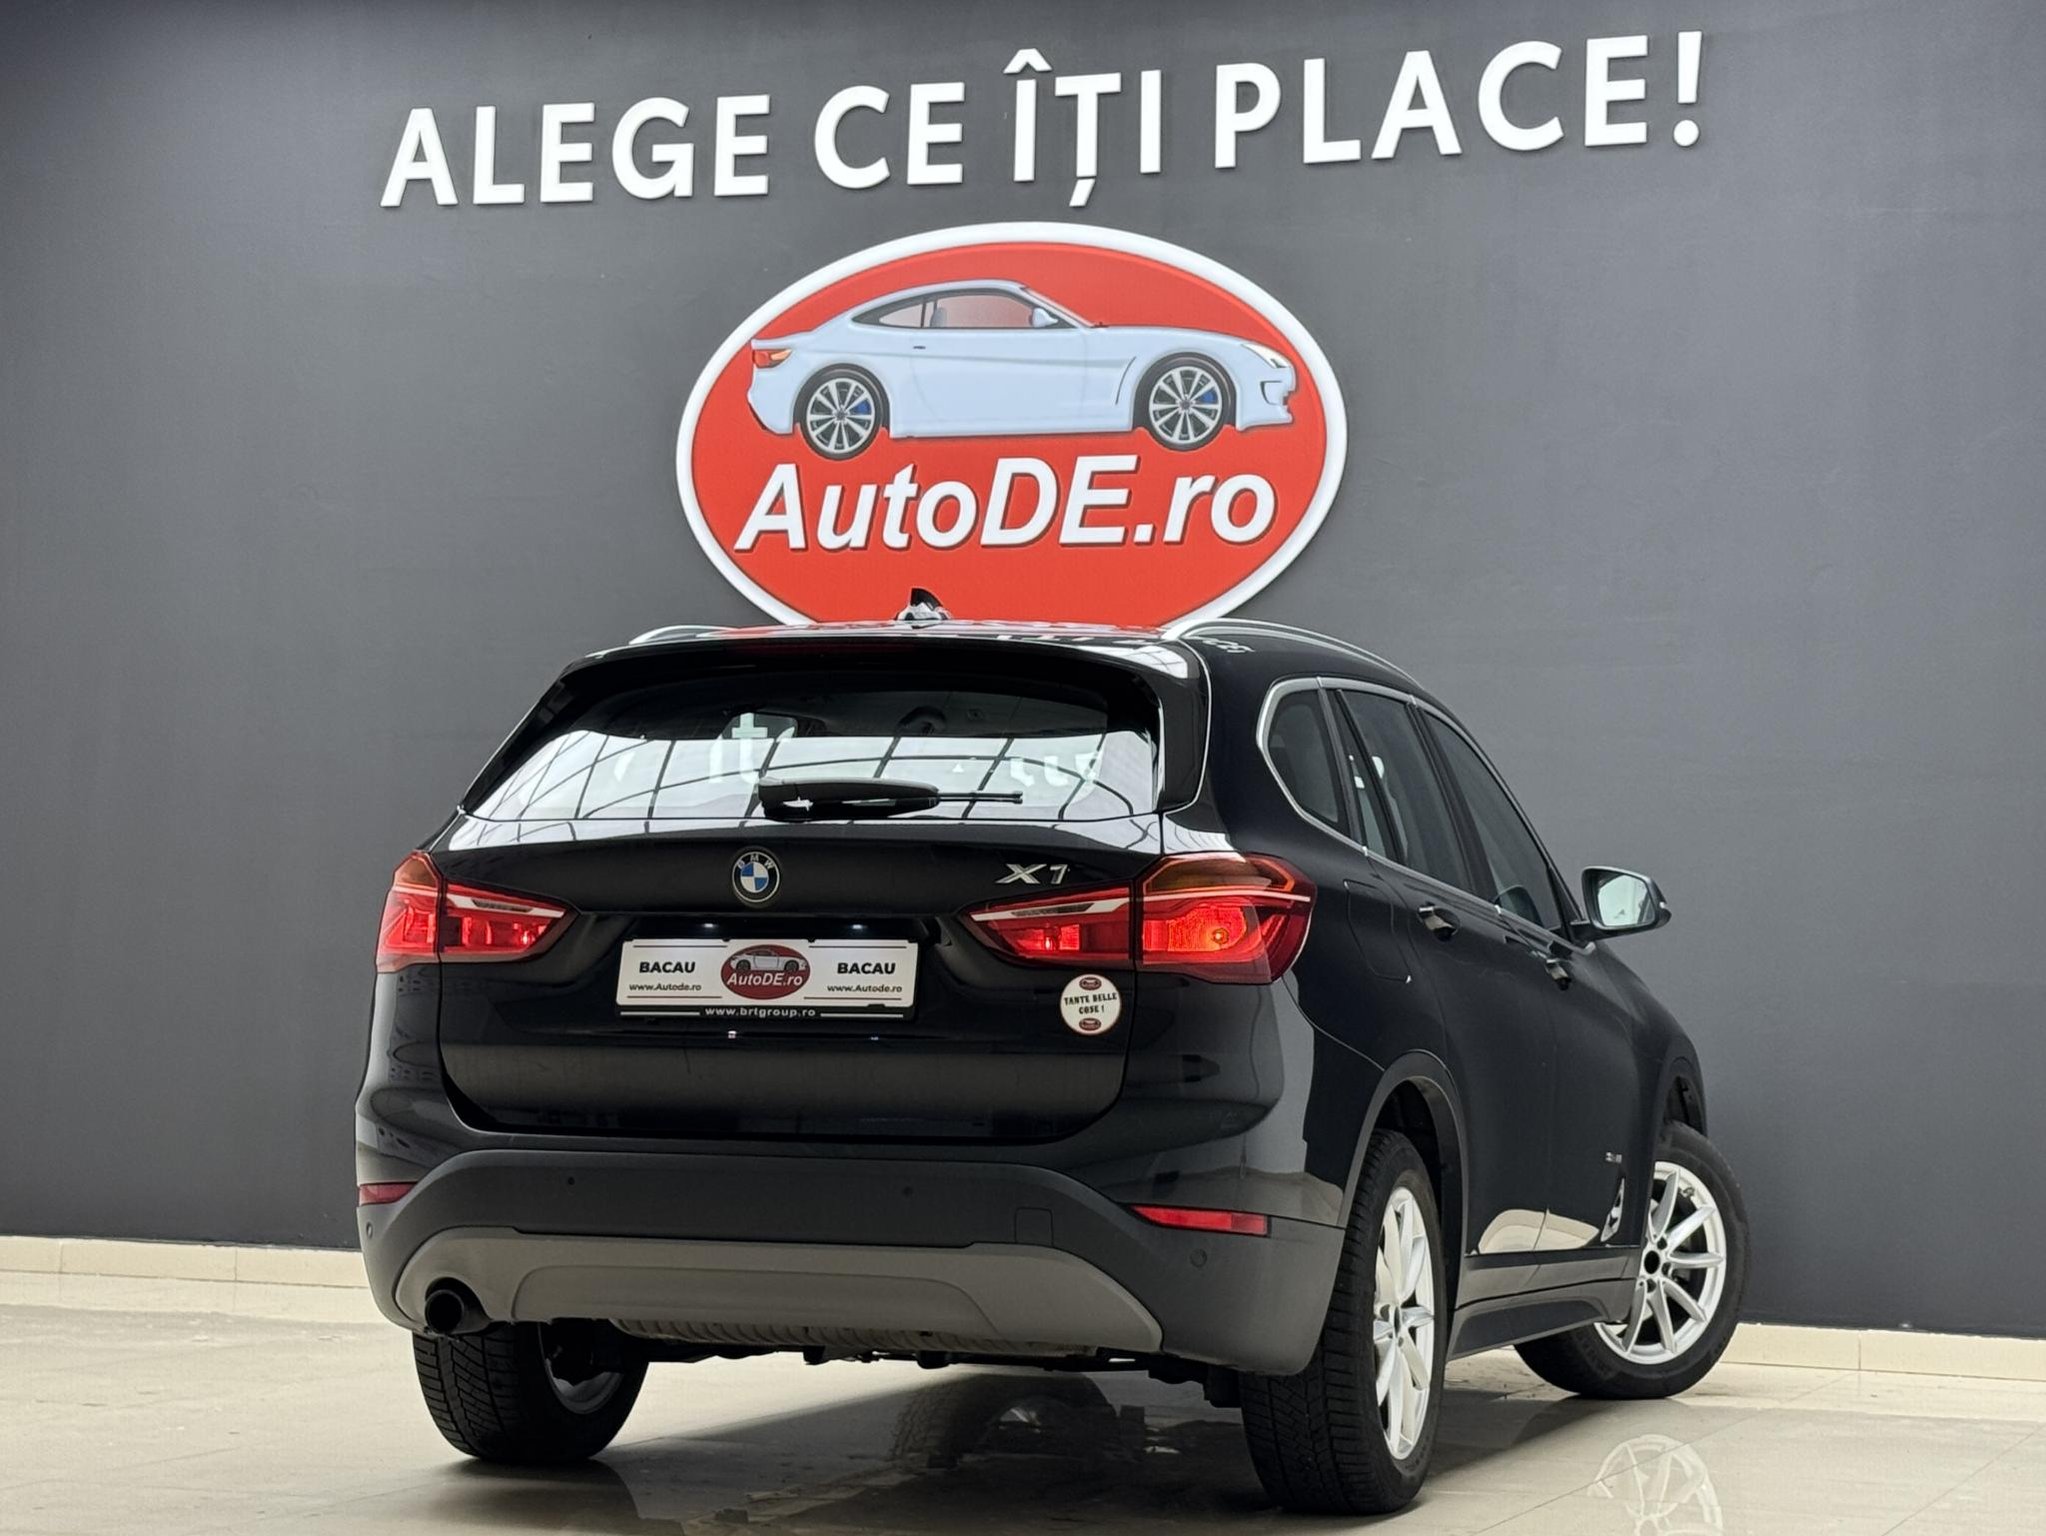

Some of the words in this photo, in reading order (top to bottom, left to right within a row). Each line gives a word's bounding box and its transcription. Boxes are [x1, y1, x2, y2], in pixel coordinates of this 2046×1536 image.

[380, 94, 771, 208] ALEGE
[813, 81, 966, 189] CE
[1213, 30, 1703, 169] PLACE!
[733, 453, 1279, 553] AutoDE.ro
[737, 852, 776, 870] BMW
[994, 863, 1069, 885] X1
[638, 961, 697, 974] BACAU
[836, 962, 897, 975] BACAU
[726, 972, 803, 987] AutoDE.ro
[628, 983, 702, 992] www.Autode.ro
[826, 984, 903, 994] www.Autode.ro
[1064, 994, 1090, 1006] TANTE
